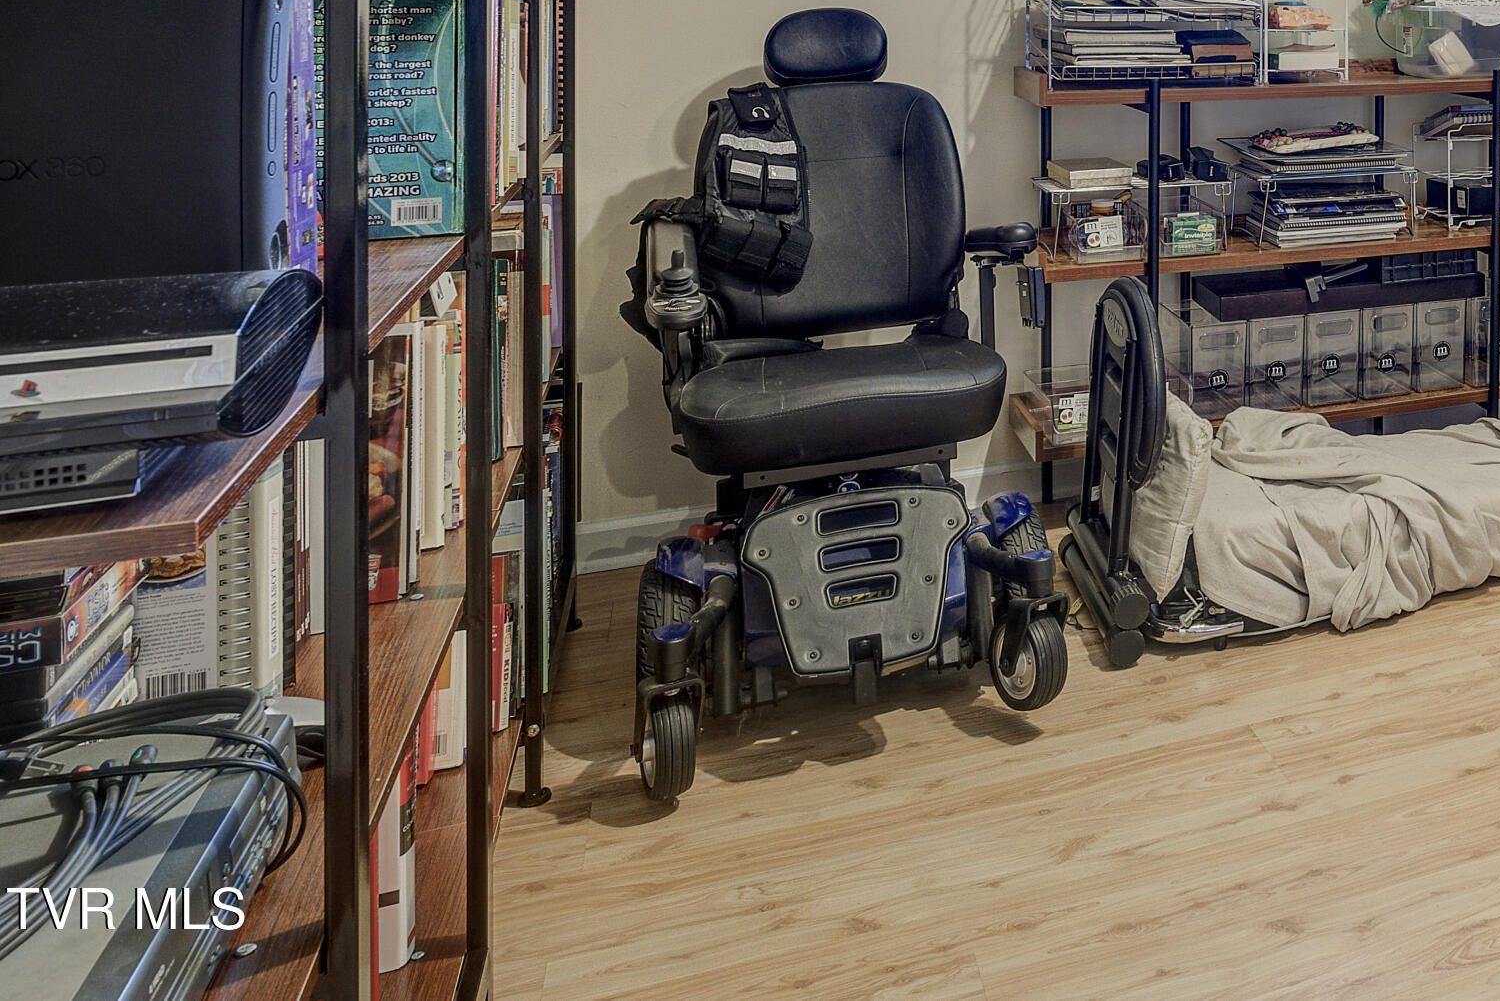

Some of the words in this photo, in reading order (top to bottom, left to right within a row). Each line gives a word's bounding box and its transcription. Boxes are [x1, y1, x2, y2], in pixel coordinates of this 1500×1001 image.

[381, 17, 414, 26] baby?
[398, 34, 435, 42] donkey
[370, 45, 397, 54] dog?
[394, 61, 431, 70] largest
[394, 71, 424, 79] road?
[401, 87, 436, 96] fastest
[374, 99, 412, 108] sheep?
[399, 133, 436, 142] Reality
[387, 145, 406, 153] life
[390, 173, 419, 182] 2013
